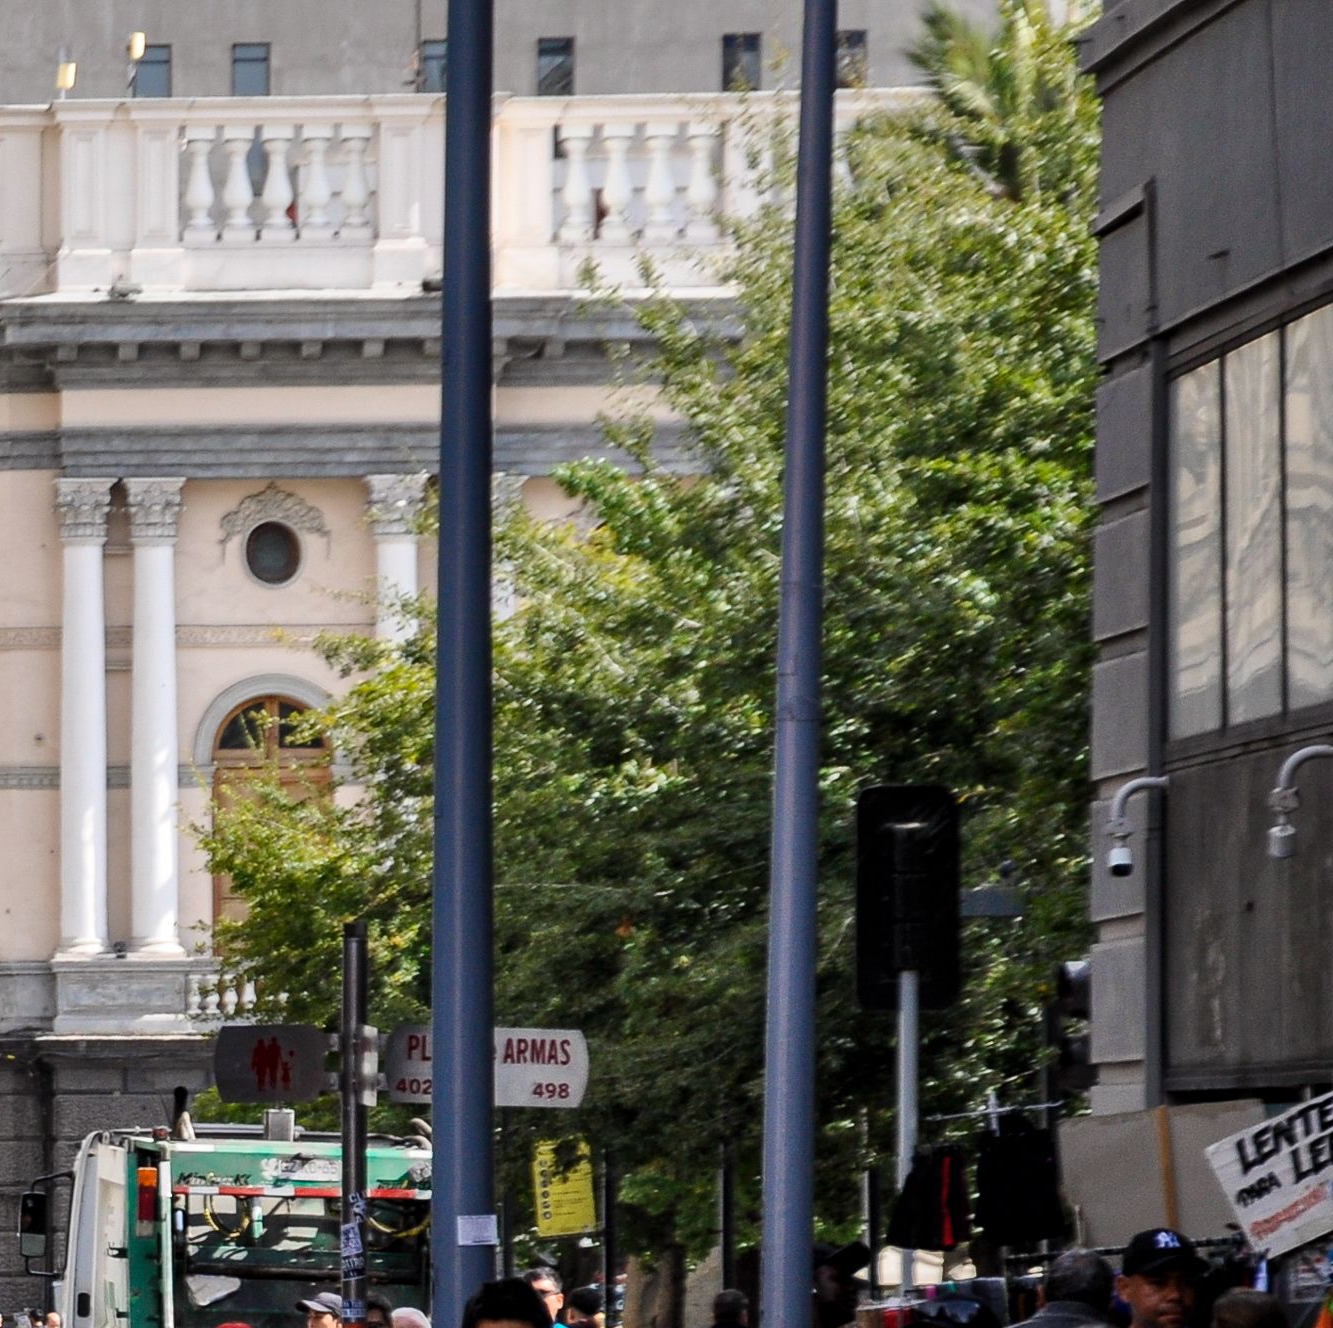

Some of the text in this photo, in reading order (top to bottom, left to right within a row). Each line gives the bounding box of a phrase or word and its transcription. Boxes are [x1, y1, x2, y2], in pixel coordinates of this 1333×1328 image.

[502, 1037, 571, 1066] ARMAS
[396, 1078, 432, 1095] 402
[532, 1082, 570, 1099] 498
